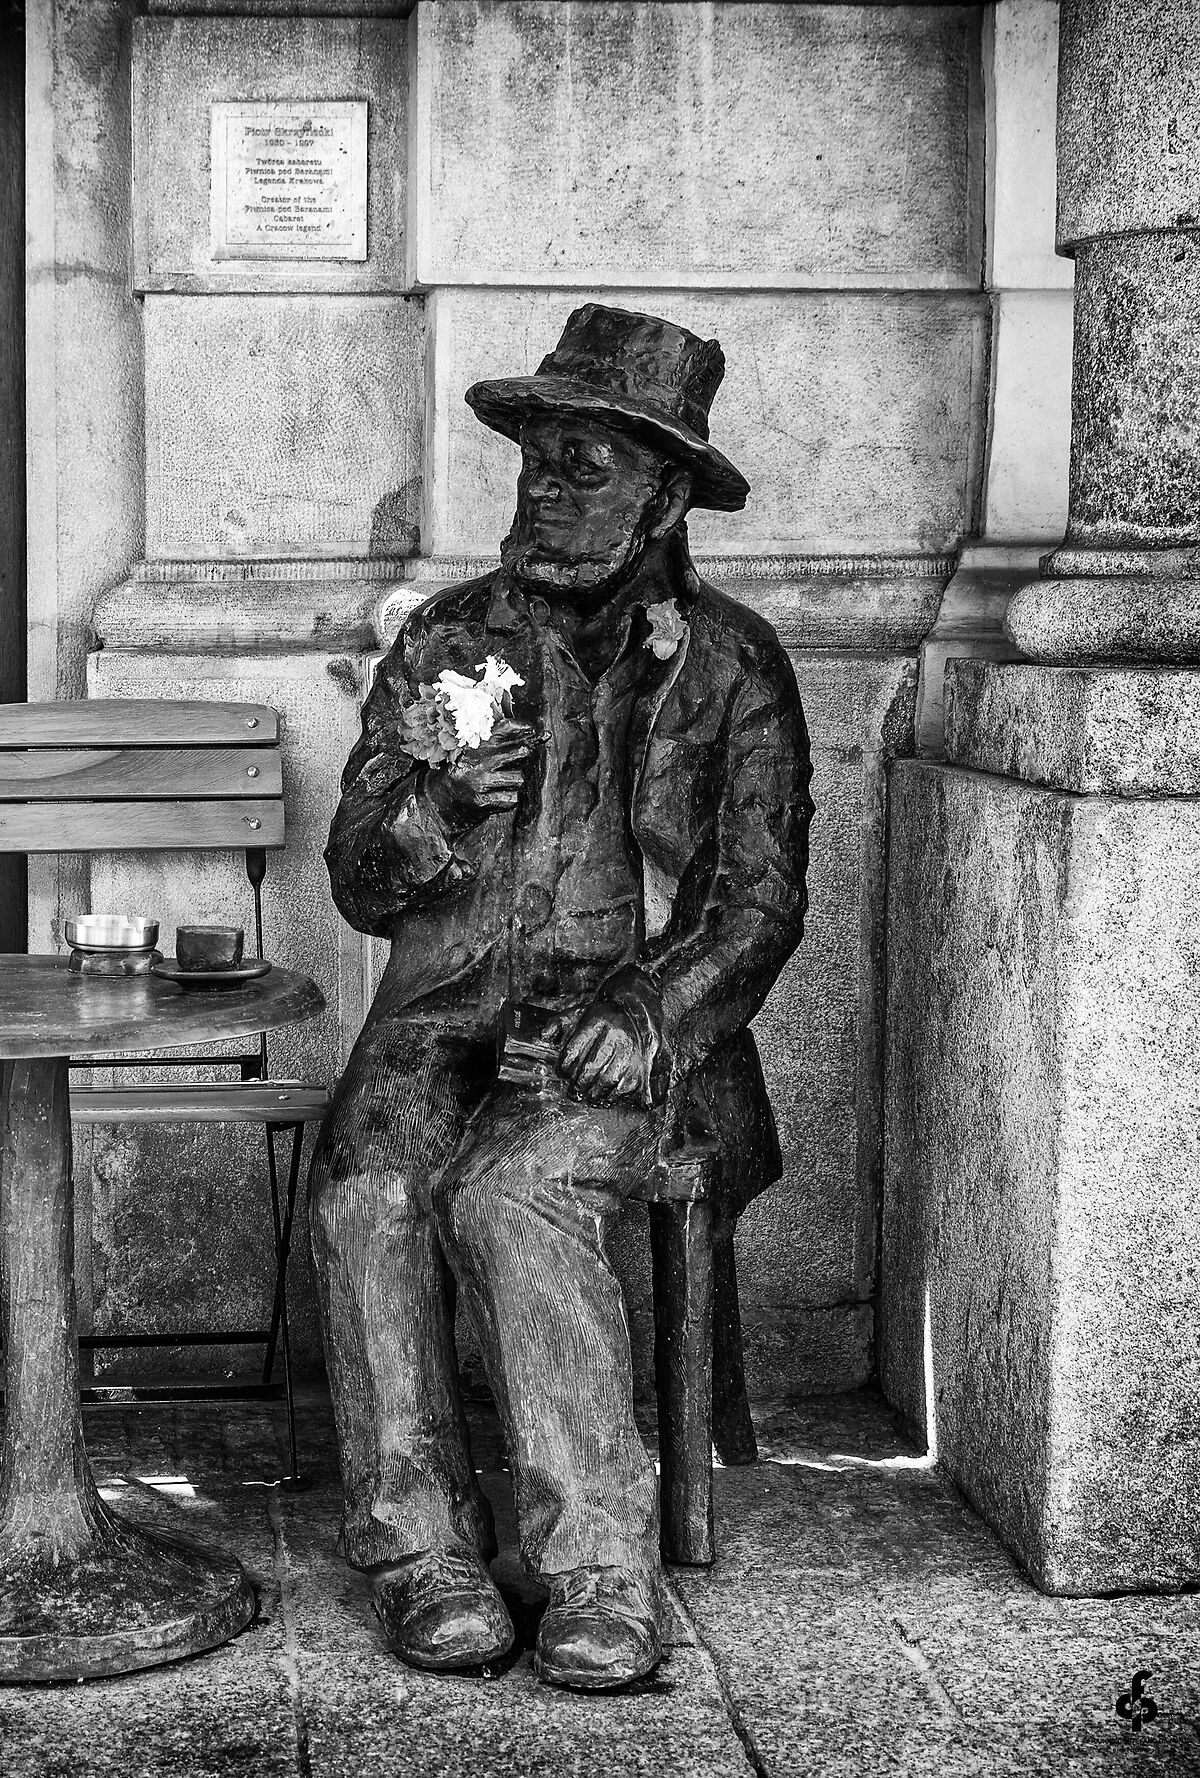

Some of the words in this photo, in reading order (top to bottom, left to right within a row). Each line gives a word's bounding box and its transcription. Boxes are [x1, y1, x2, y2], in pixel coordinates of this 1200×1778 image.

[244, 126, 271, 137] Piotr
[264, 139, 285, 147] 1930
[295, 139, 315, 147] 1997
[287, 158, 322, 166] kabaretu
[245, 167, 276, 175] Piwnica
[278, 167, 292, 176] pod
[294, 167, 333, 176] Baranami
[254, 177, 286, 185] Legenda
[288, 177, 324, 185] Krakowa
[261, 195, 291, 203] Creator
[293, 195, 301, 204] of
[245, 205, 275, 213] Piwnica
[278, 205, 292, 213] pod
[294, 205, 333, 213] Baranami
[256, 224, 263, 232] A
[265, 224, 294, 232] Cracow
[296, 224, 322, 233] legend
